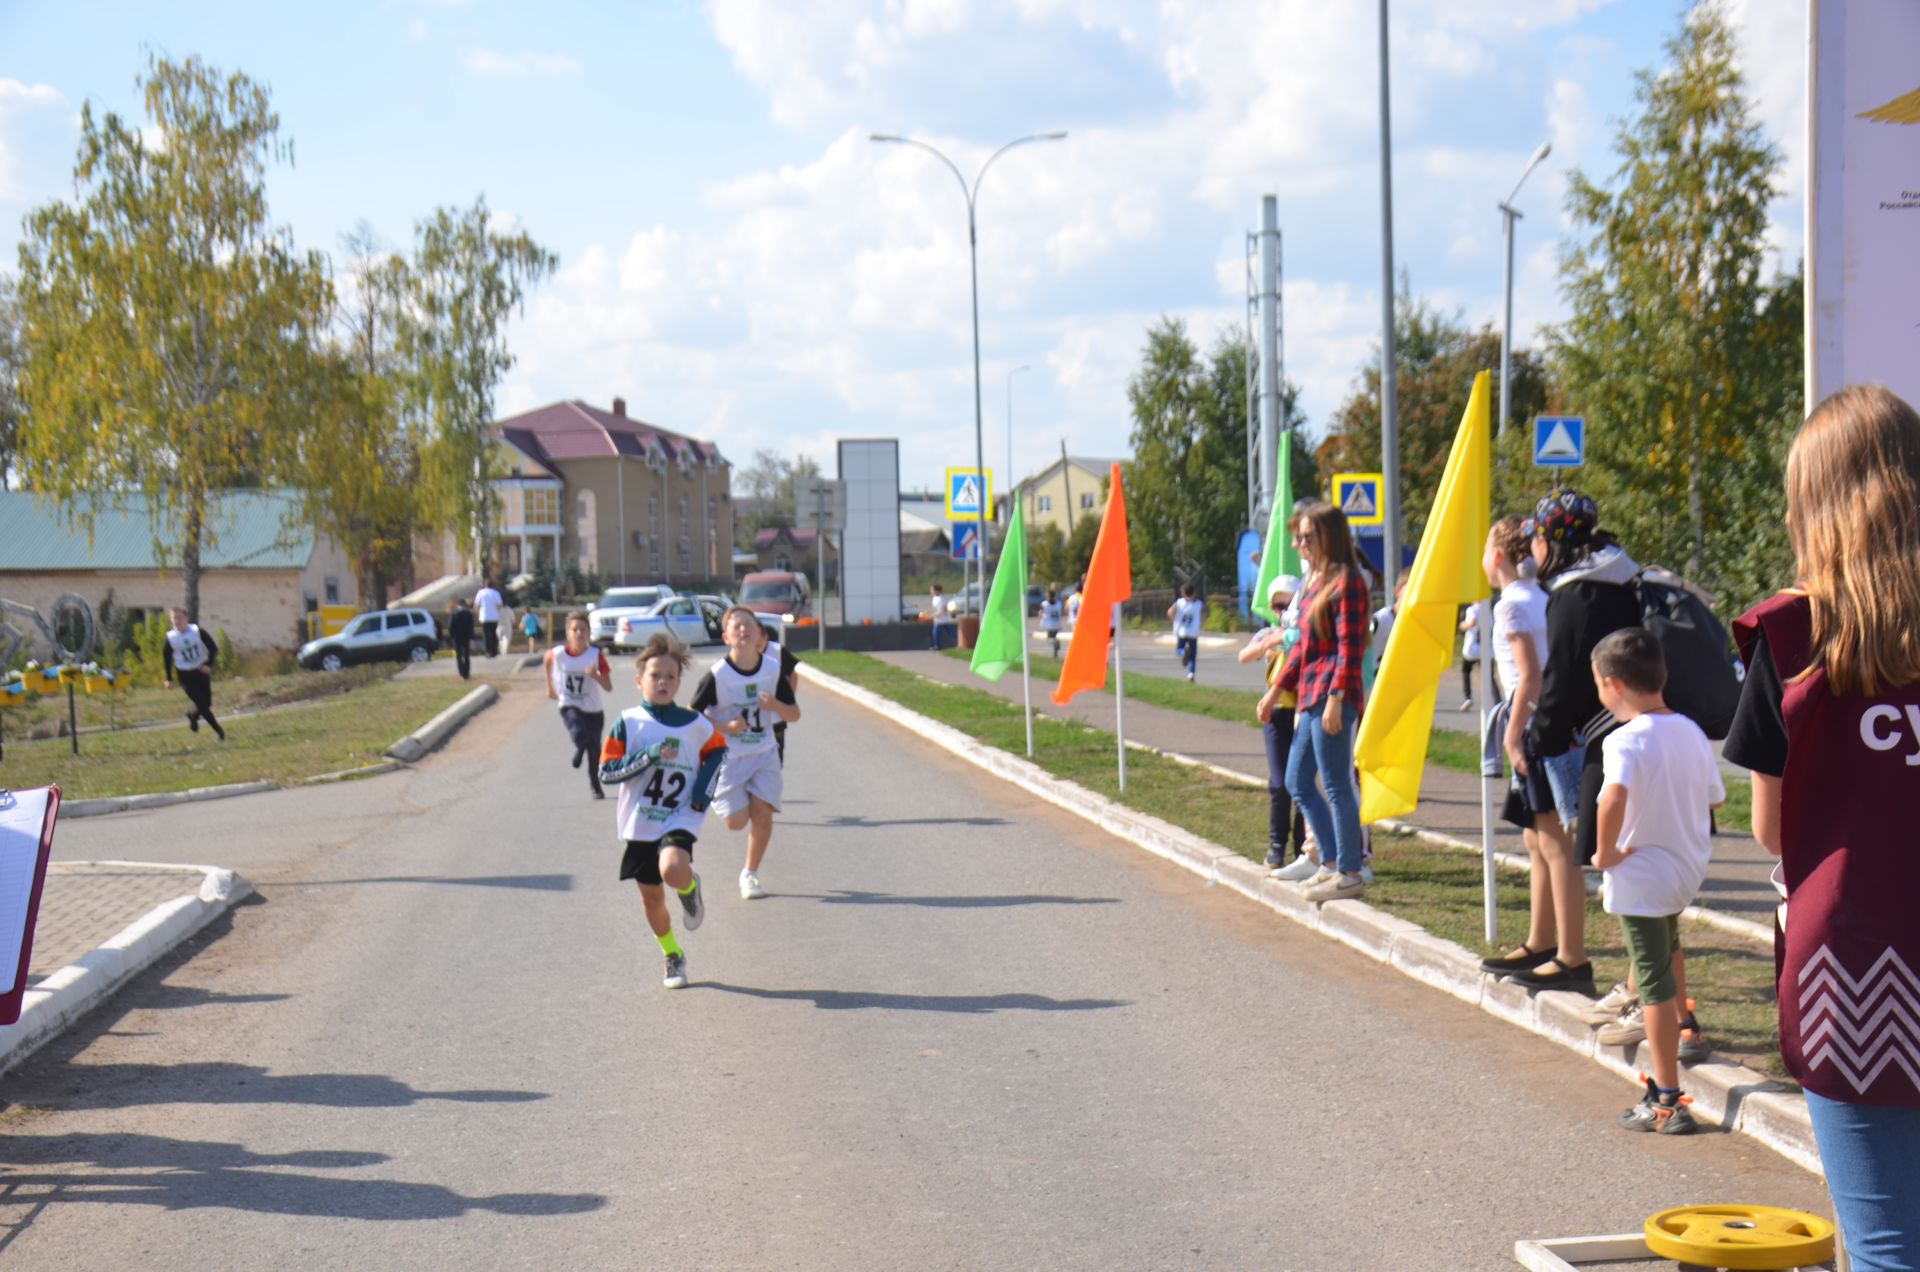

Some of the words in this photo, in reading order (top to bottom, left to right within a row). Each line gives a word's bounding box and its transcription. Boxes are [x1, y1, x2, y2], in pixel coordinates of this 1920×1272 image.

[1880, 200, 1920, 210] Российс
[565, 675, 584, 693] 47
[643, 768, 687, 809] 42
